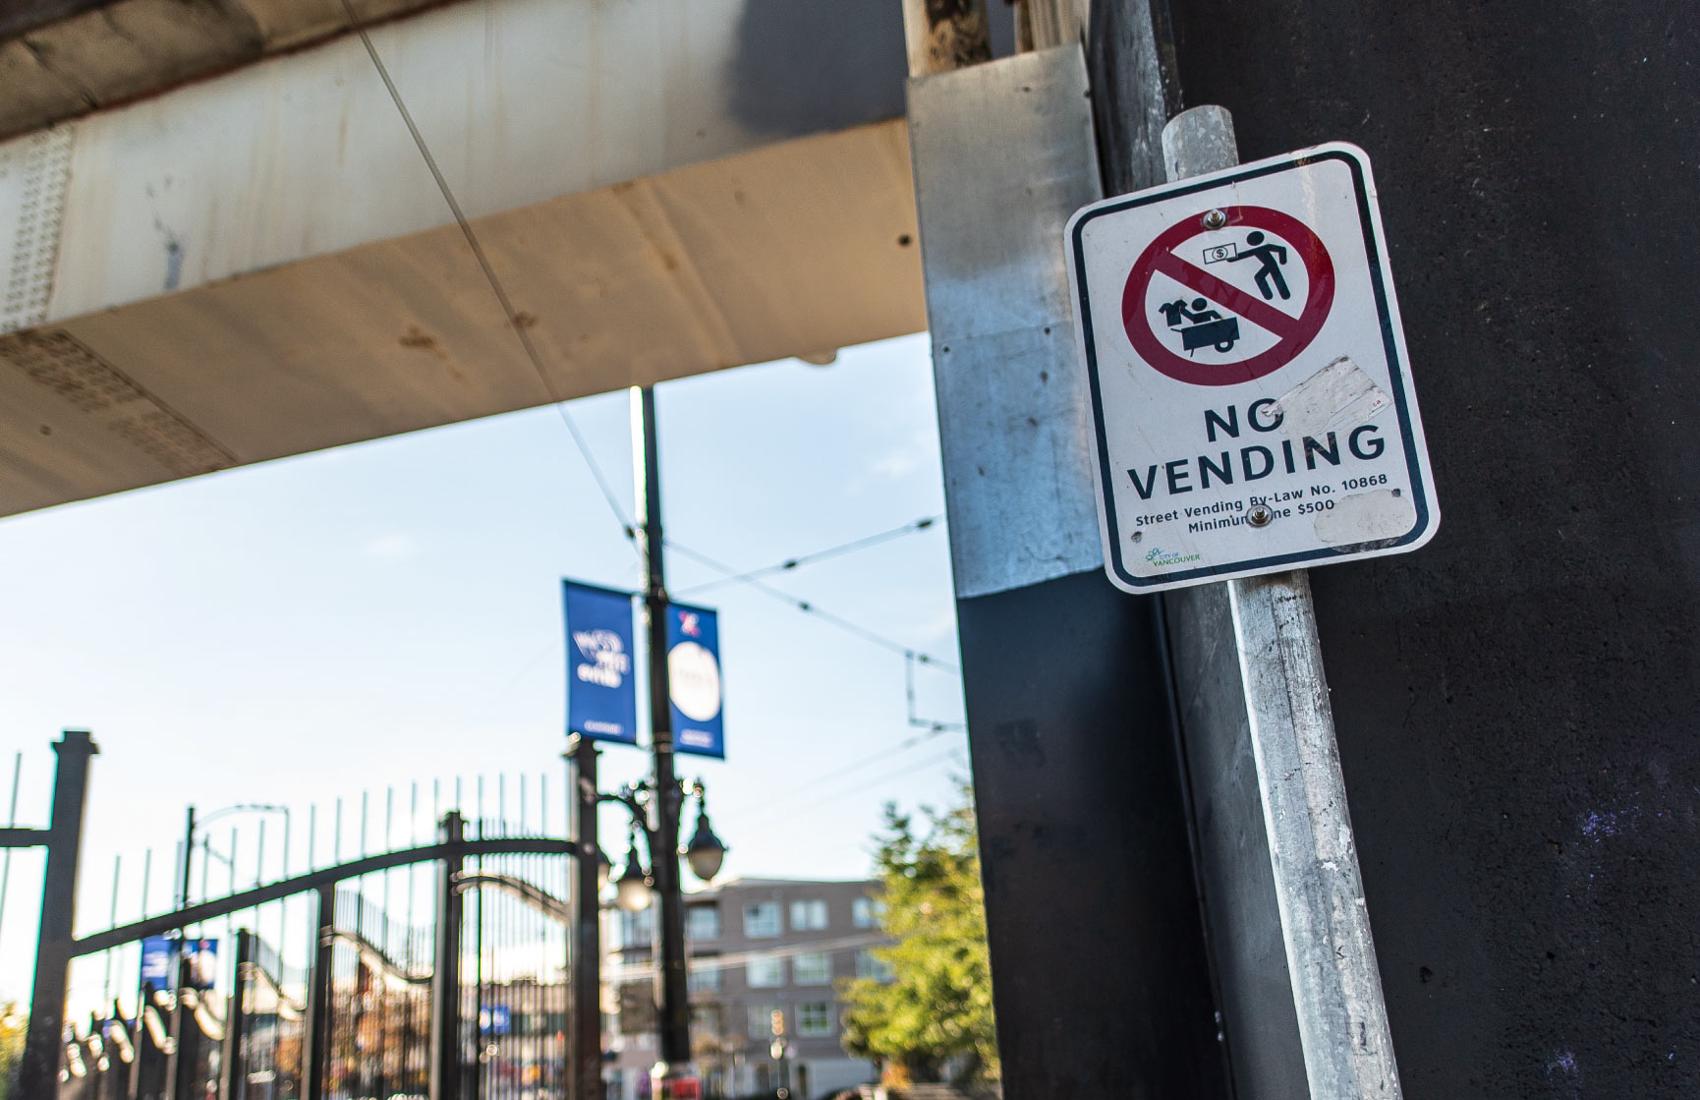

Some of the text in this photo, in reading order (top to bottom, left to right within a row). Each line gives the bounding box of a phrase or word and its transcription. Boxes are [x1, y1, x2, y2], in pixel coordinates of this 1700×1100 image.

[1204, 398, 1284, 442] NO
[1127, 425, 1386, 500] VENDING
[1136, 474, 1388, 526] Street Vending By-Law No. 10868
[1298, 499, 1335, 515] $500
[1152, 553, 1201, 566] VANCOUVER
